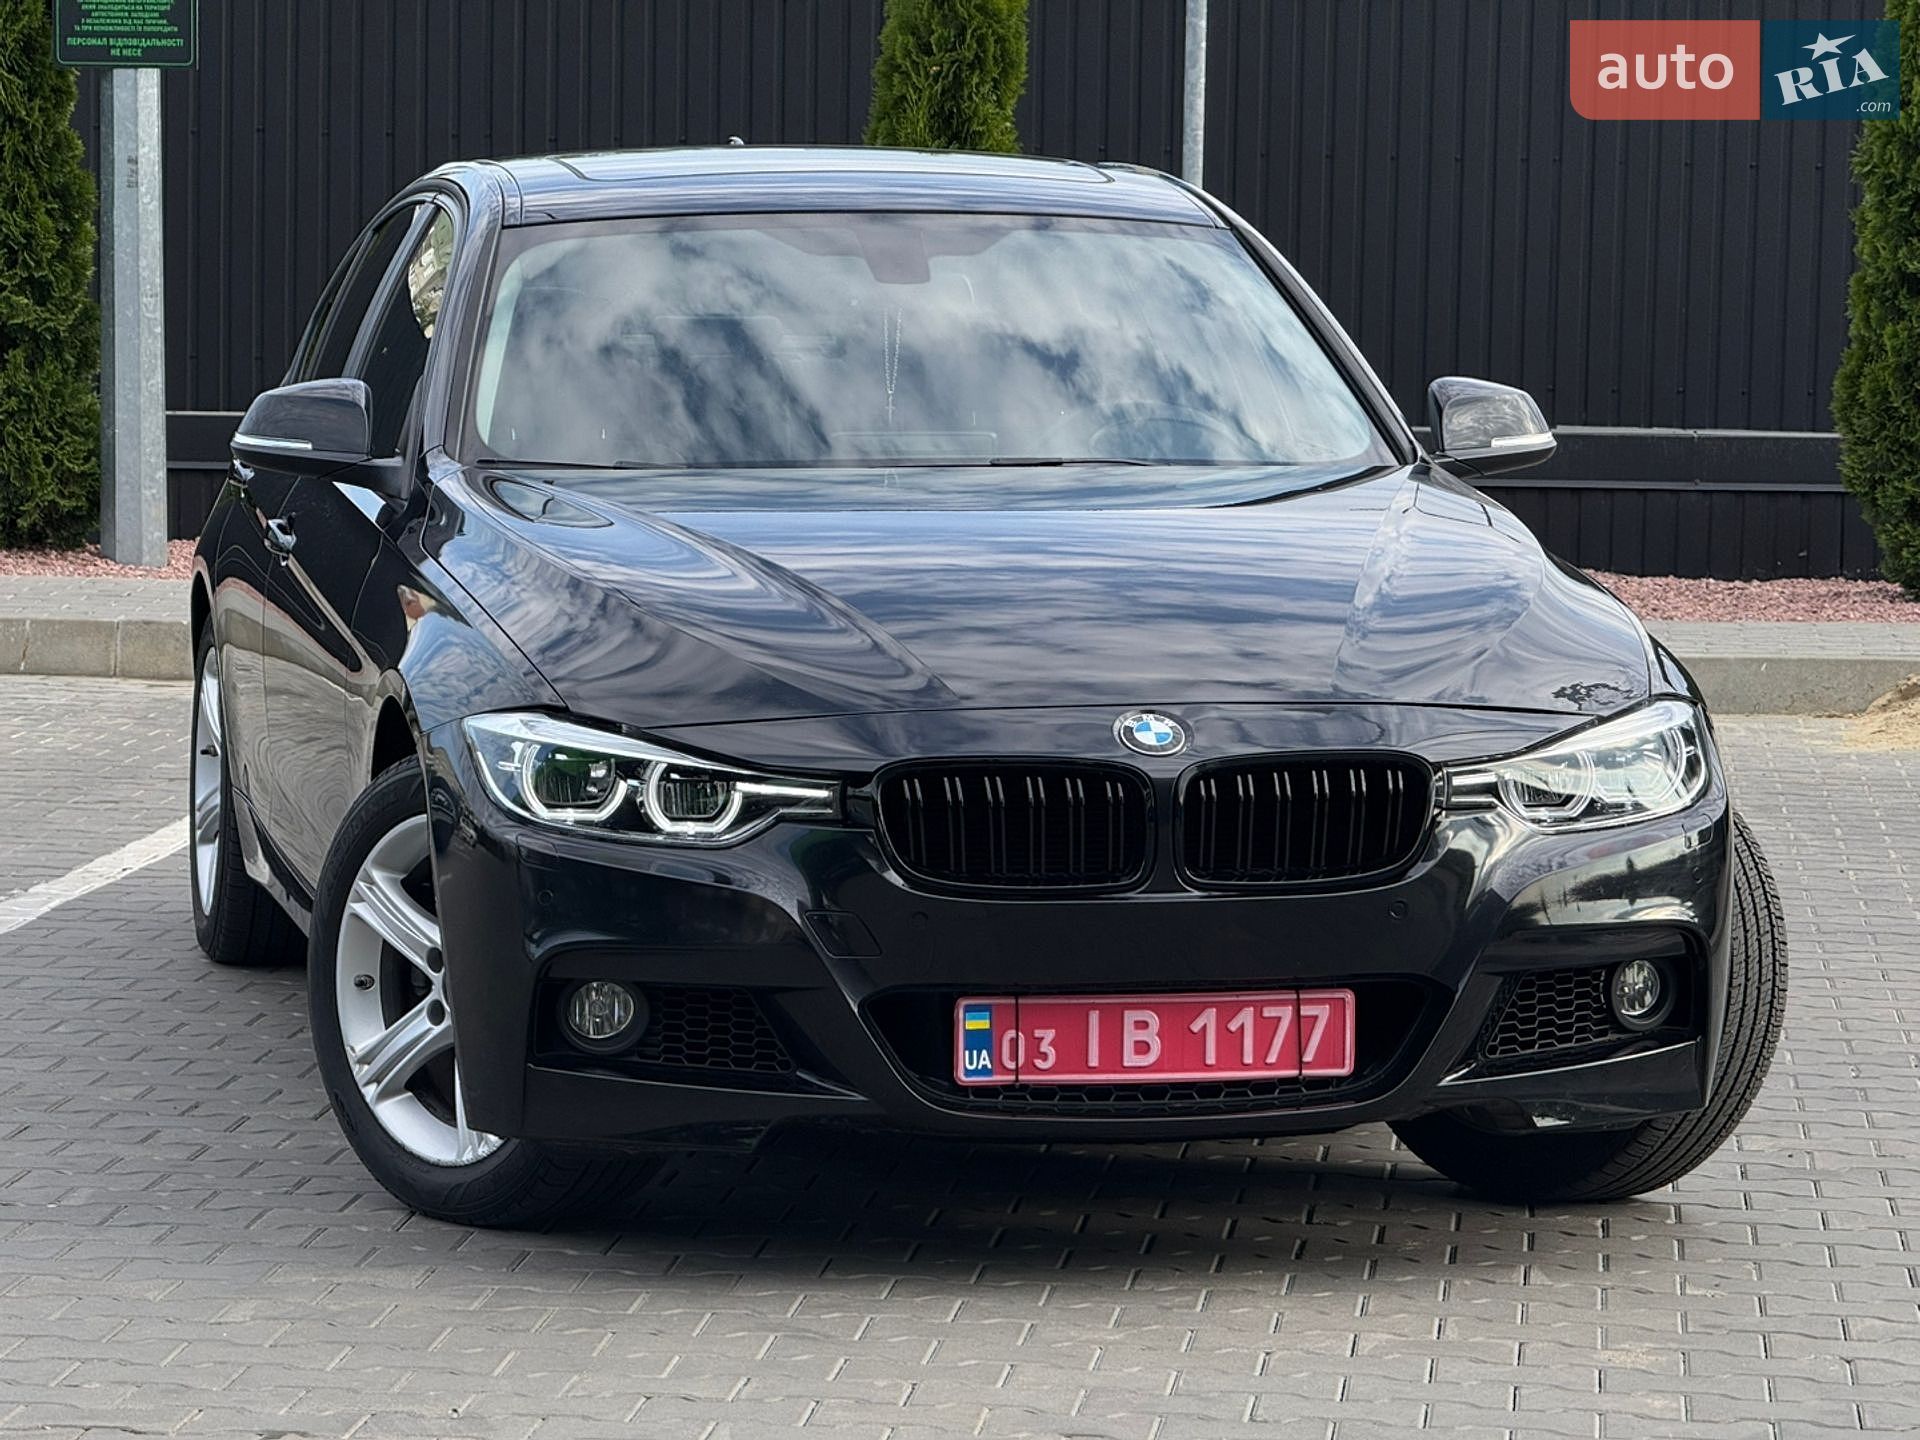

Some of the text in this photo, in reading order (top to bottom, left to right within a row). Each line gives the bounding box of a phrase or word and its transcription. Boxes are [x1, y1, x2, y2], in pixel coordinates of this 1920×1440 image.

[67, 37, 184, 47] ПЕРСОНАЛ ВІДПОВІДАЛЬНОСТІ
[110, 48, 143, 56] НЕ НЕСЕ
[965, 1049, 992, 1070] UA
[1000, 1029, 1056, 1070] 03
[1188, 1004, 1330, 1066] 1177
